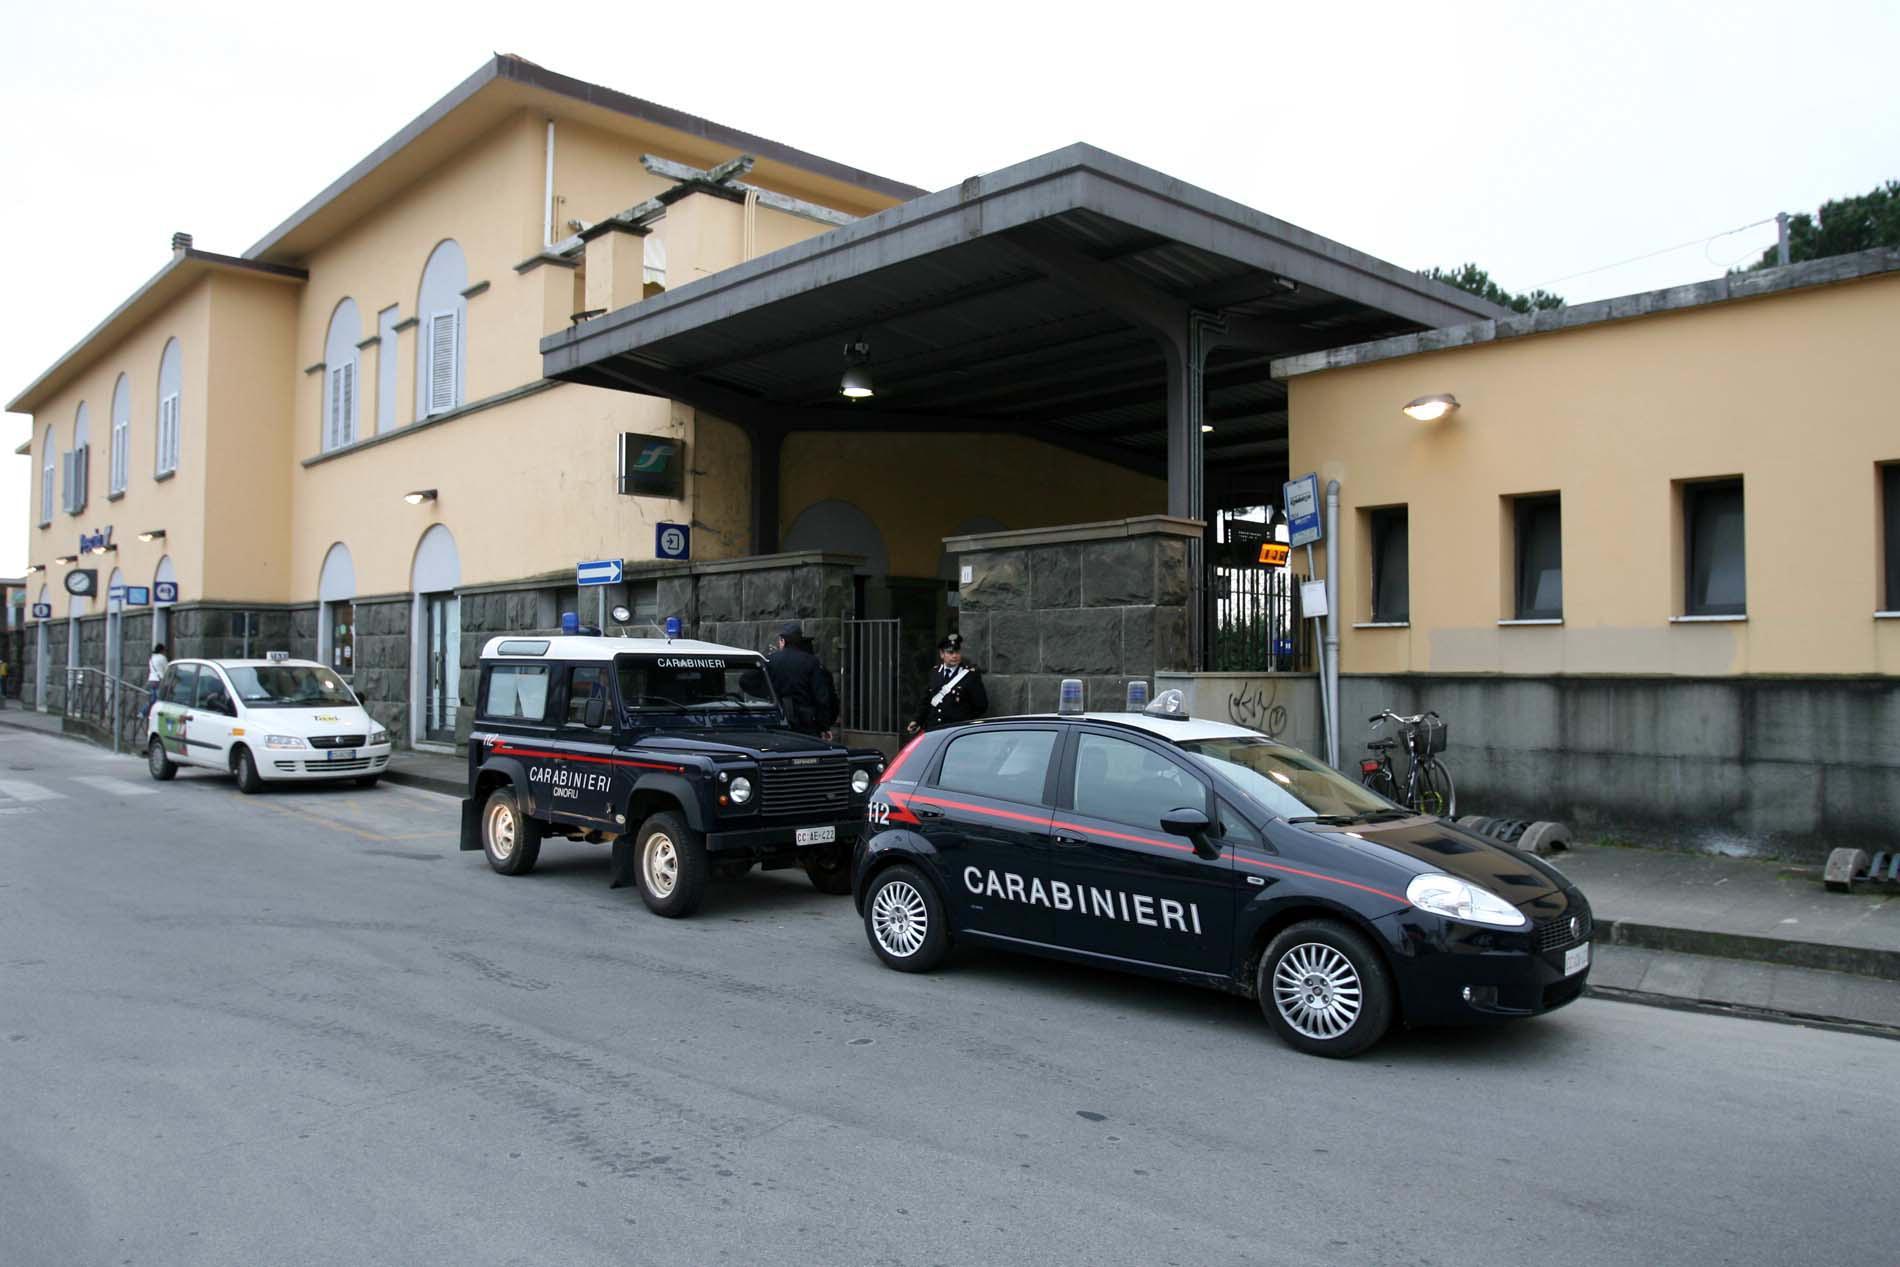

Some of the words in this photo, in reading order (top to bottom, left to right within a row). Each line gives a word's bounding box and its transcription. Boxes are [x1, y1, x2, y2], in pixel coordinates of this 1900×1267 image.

[657, 658, 726, 668] CARABINIERI
[529, 766, 611, 793] CARABINIERI
[553, 786, 579, 799] CINOFILI
[867, 800, 890, 826] 112
[963, 865, 1202, 935] CARABINIERI
